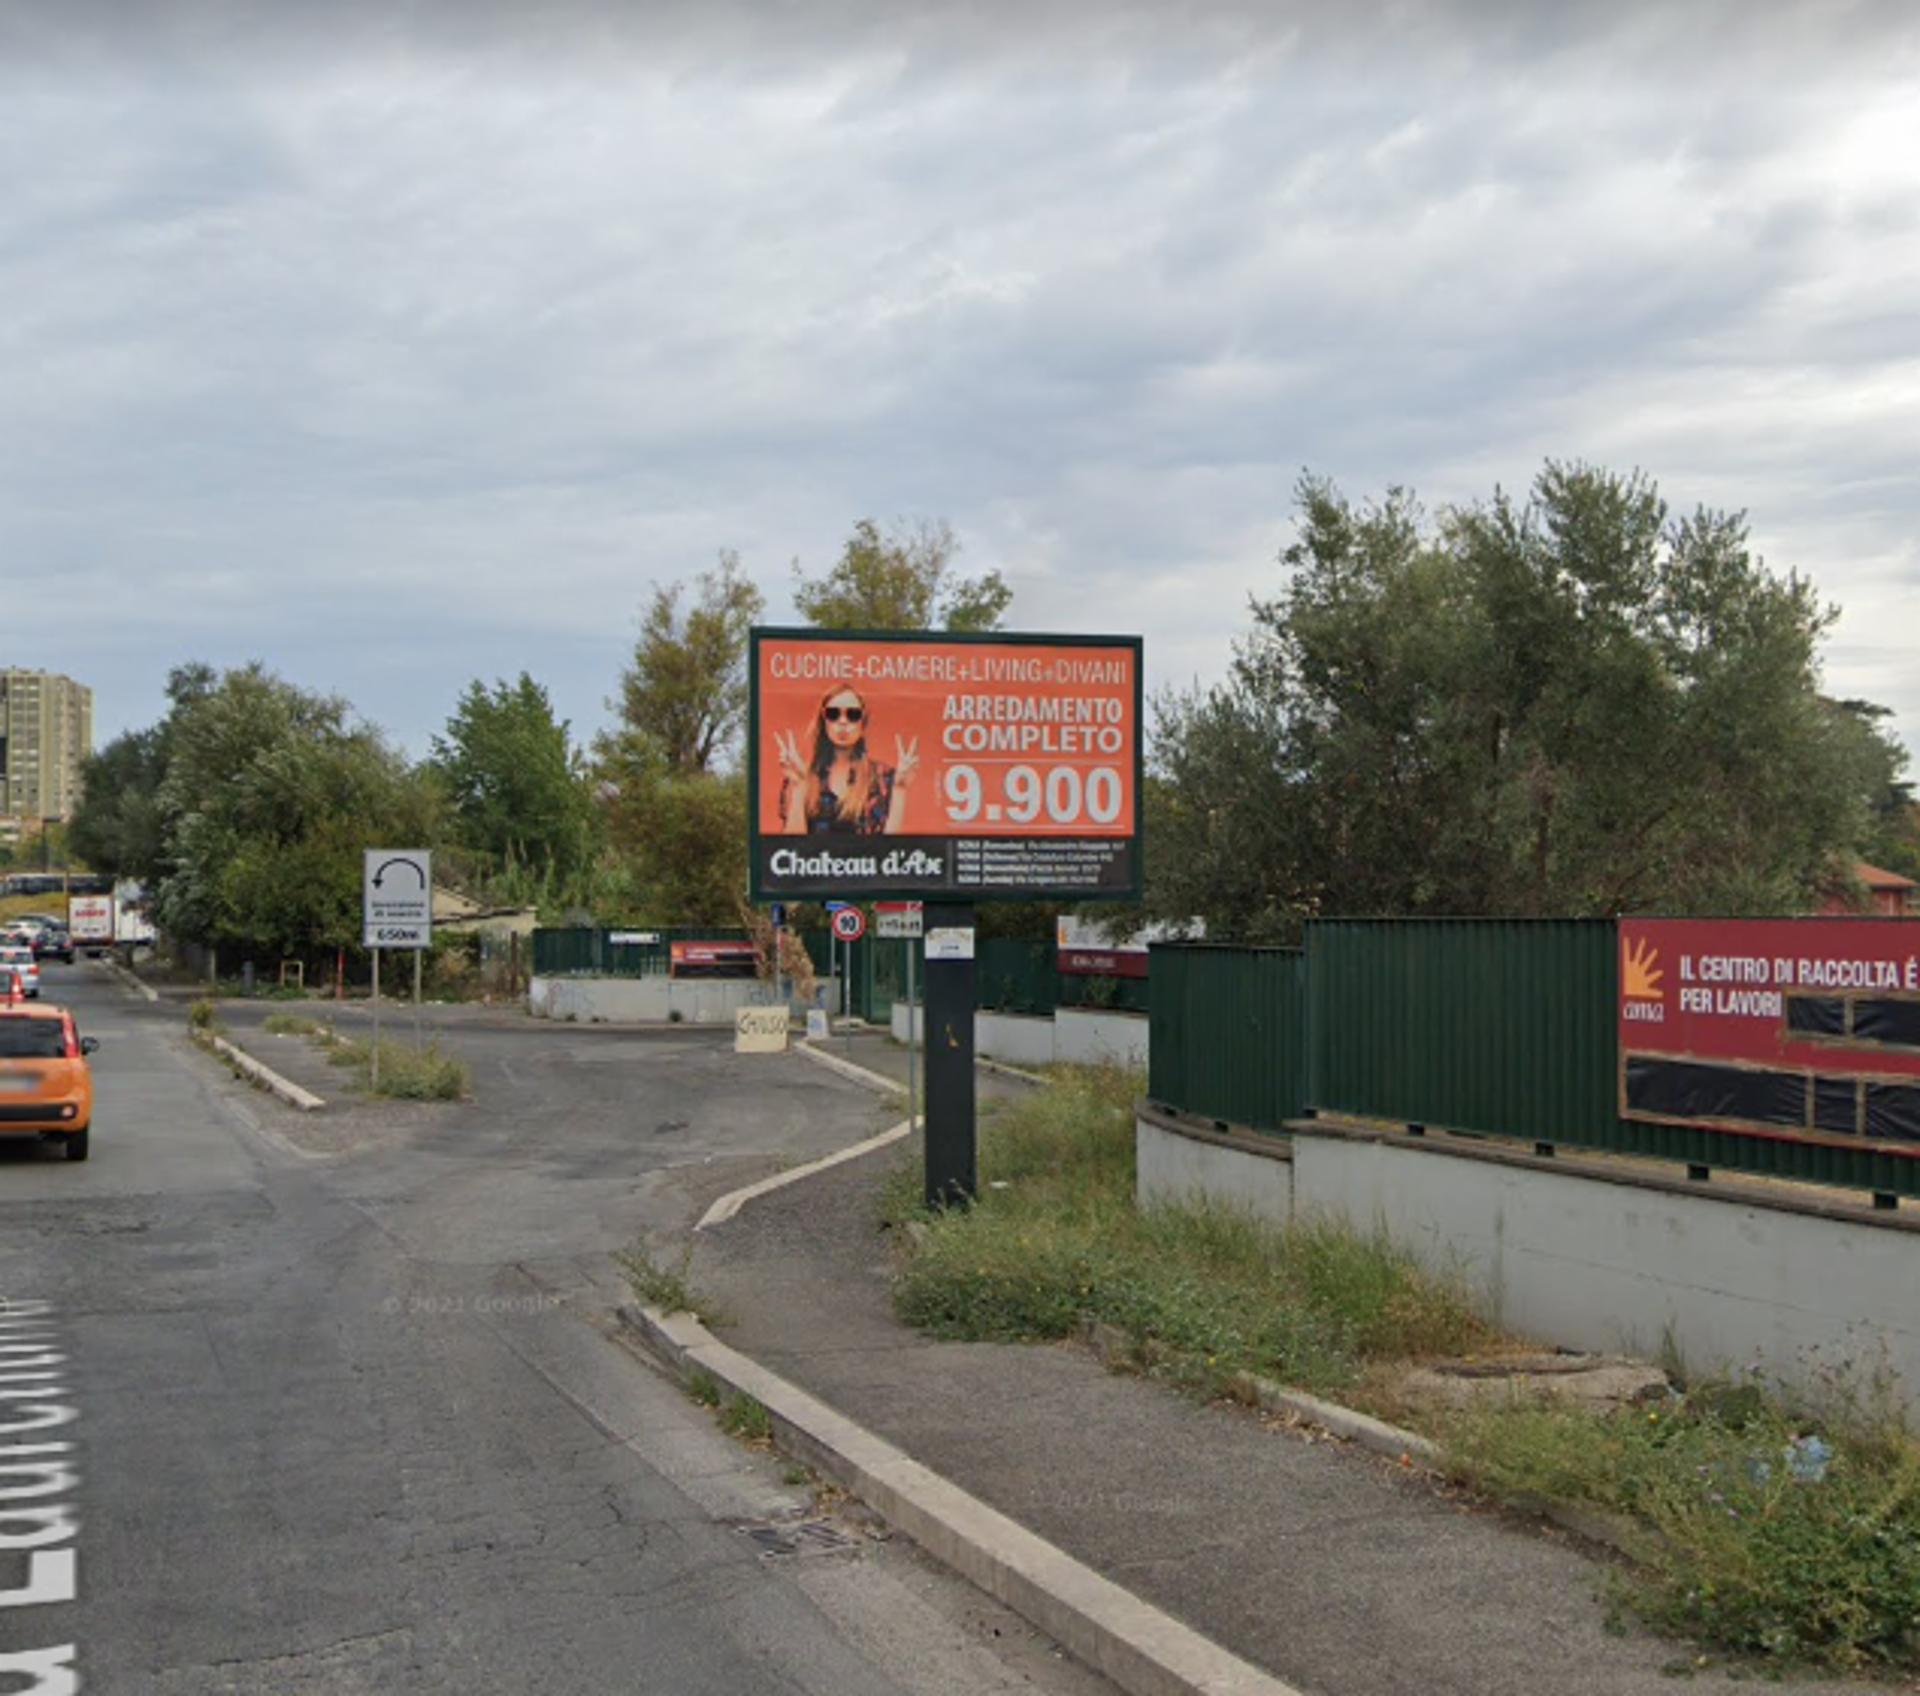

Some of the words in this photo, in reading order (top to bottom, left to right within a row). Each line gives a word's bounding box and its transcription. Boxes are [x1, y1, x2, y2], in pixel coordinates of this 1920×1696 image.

[943, 694, 1123, 724] ARREDAMENTO
[943, 723, 1123, 753] COMPLETO
[944, 764, 1122, 824] 9.900
[770, 849, 877, 877] Chateau
[881, 849, 944, 876] d'Ax
[1680, 955, 1696, 981] IL
[1699, 955, 1769, 984] CENTRO
[1774, 957, 1794, 985] DI
[1798, 958, 1900, 988] RACCOLTA
[1680, 988, 1712, 1014] PER
[1716, 989, 1782, 1017] LAVORI
